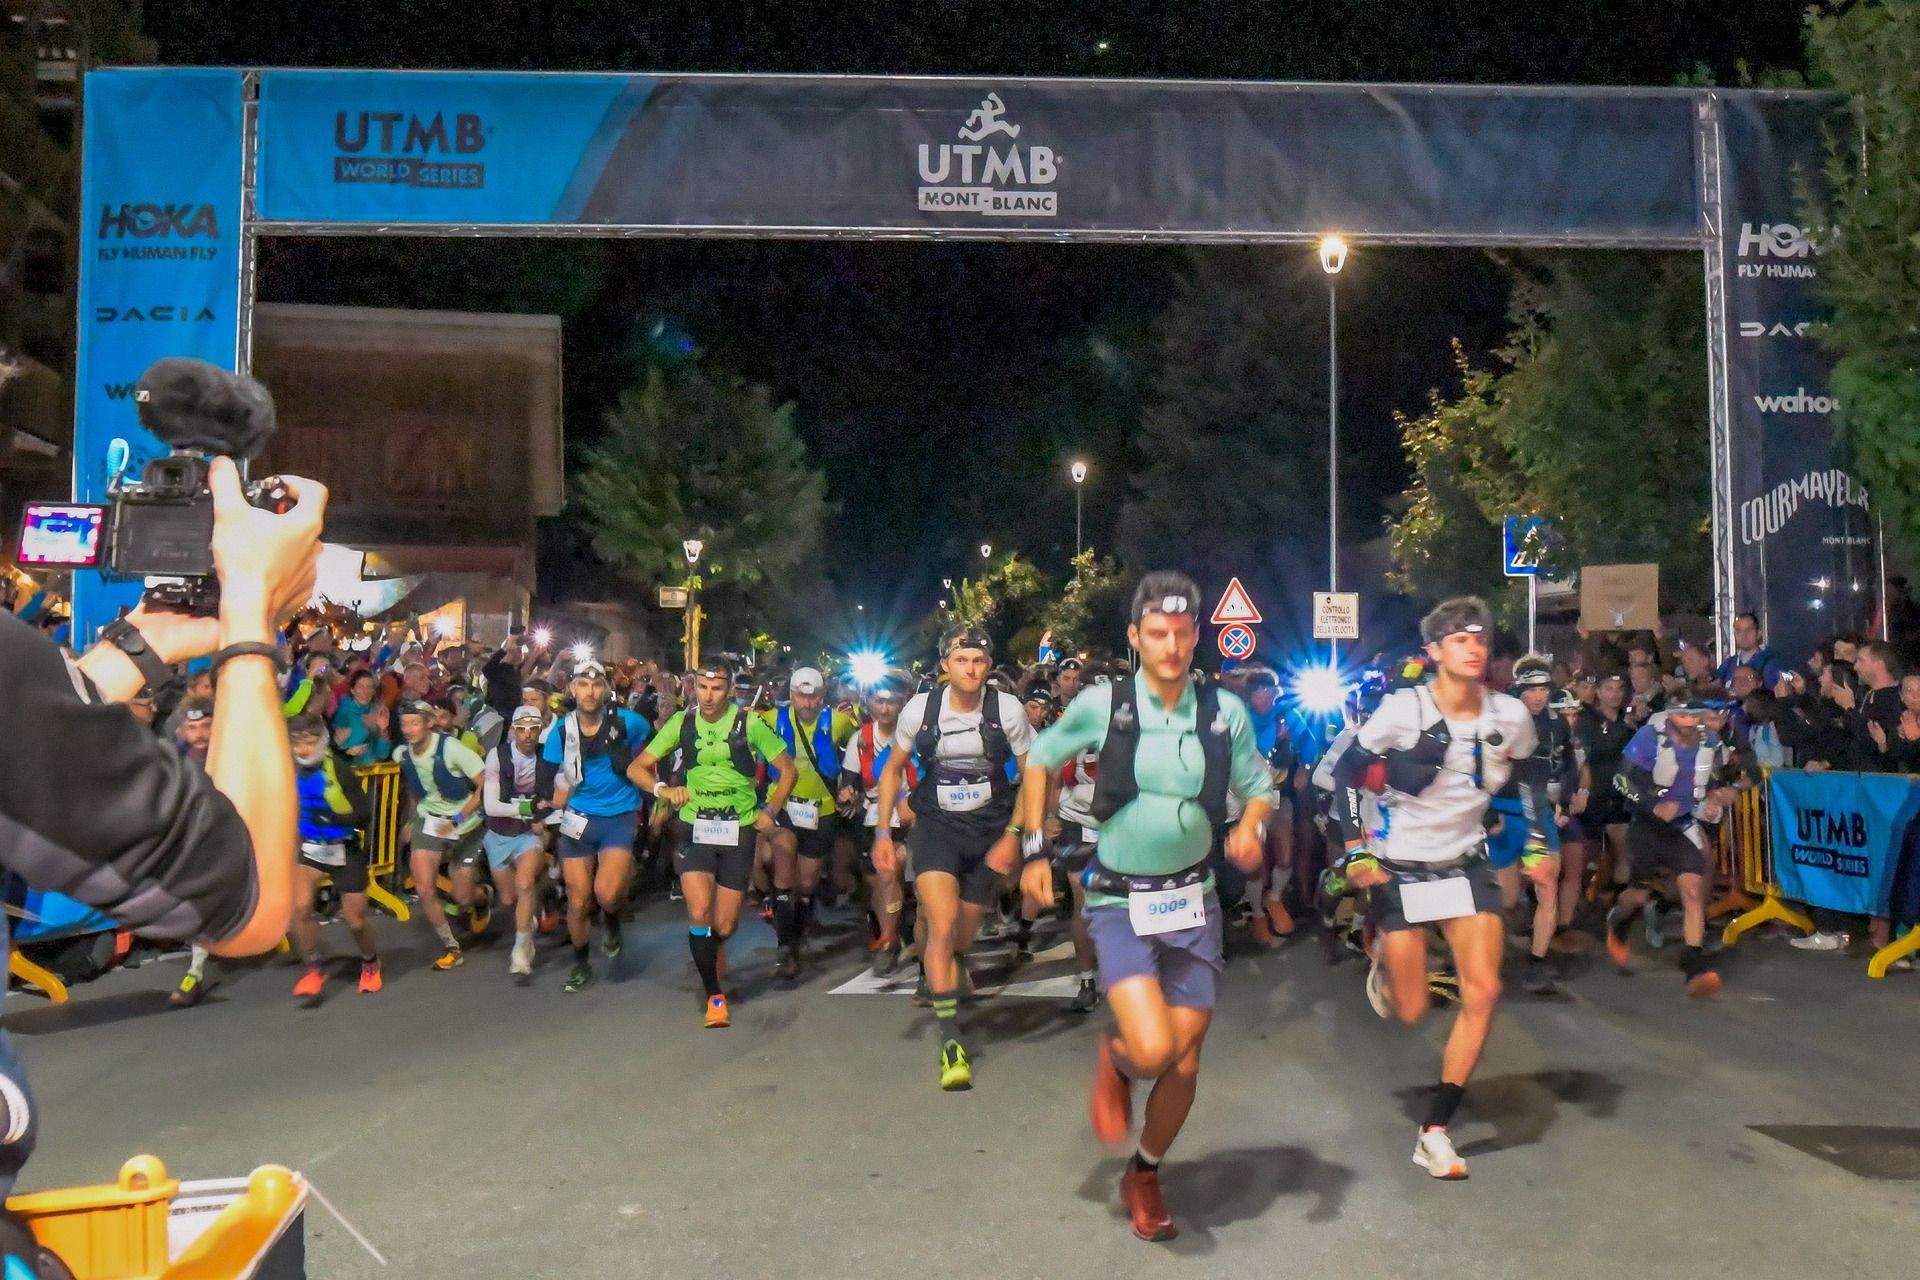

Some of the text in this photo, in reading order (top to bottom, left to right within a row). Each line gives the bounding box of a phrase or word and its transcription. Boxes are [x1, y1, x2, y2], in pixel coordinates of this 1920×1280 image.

[335, 110, 486, 153] UTMB
[341, 162, 479, 184] WORLD SERIES
[918, 143, 1058, 184] UTMB
[100, 203, 219, 239] HOKA
[99, 248, 217, 261] FLY HUMAN FLY
[1738, 264, 1764, 278] FLY
[96, 306, 216, 322] DACIA
[950, 791, 980, 801] 9016
[1797, 809, 1868, 848] UTMB
[1148, 898, 1187, 915] 9009
